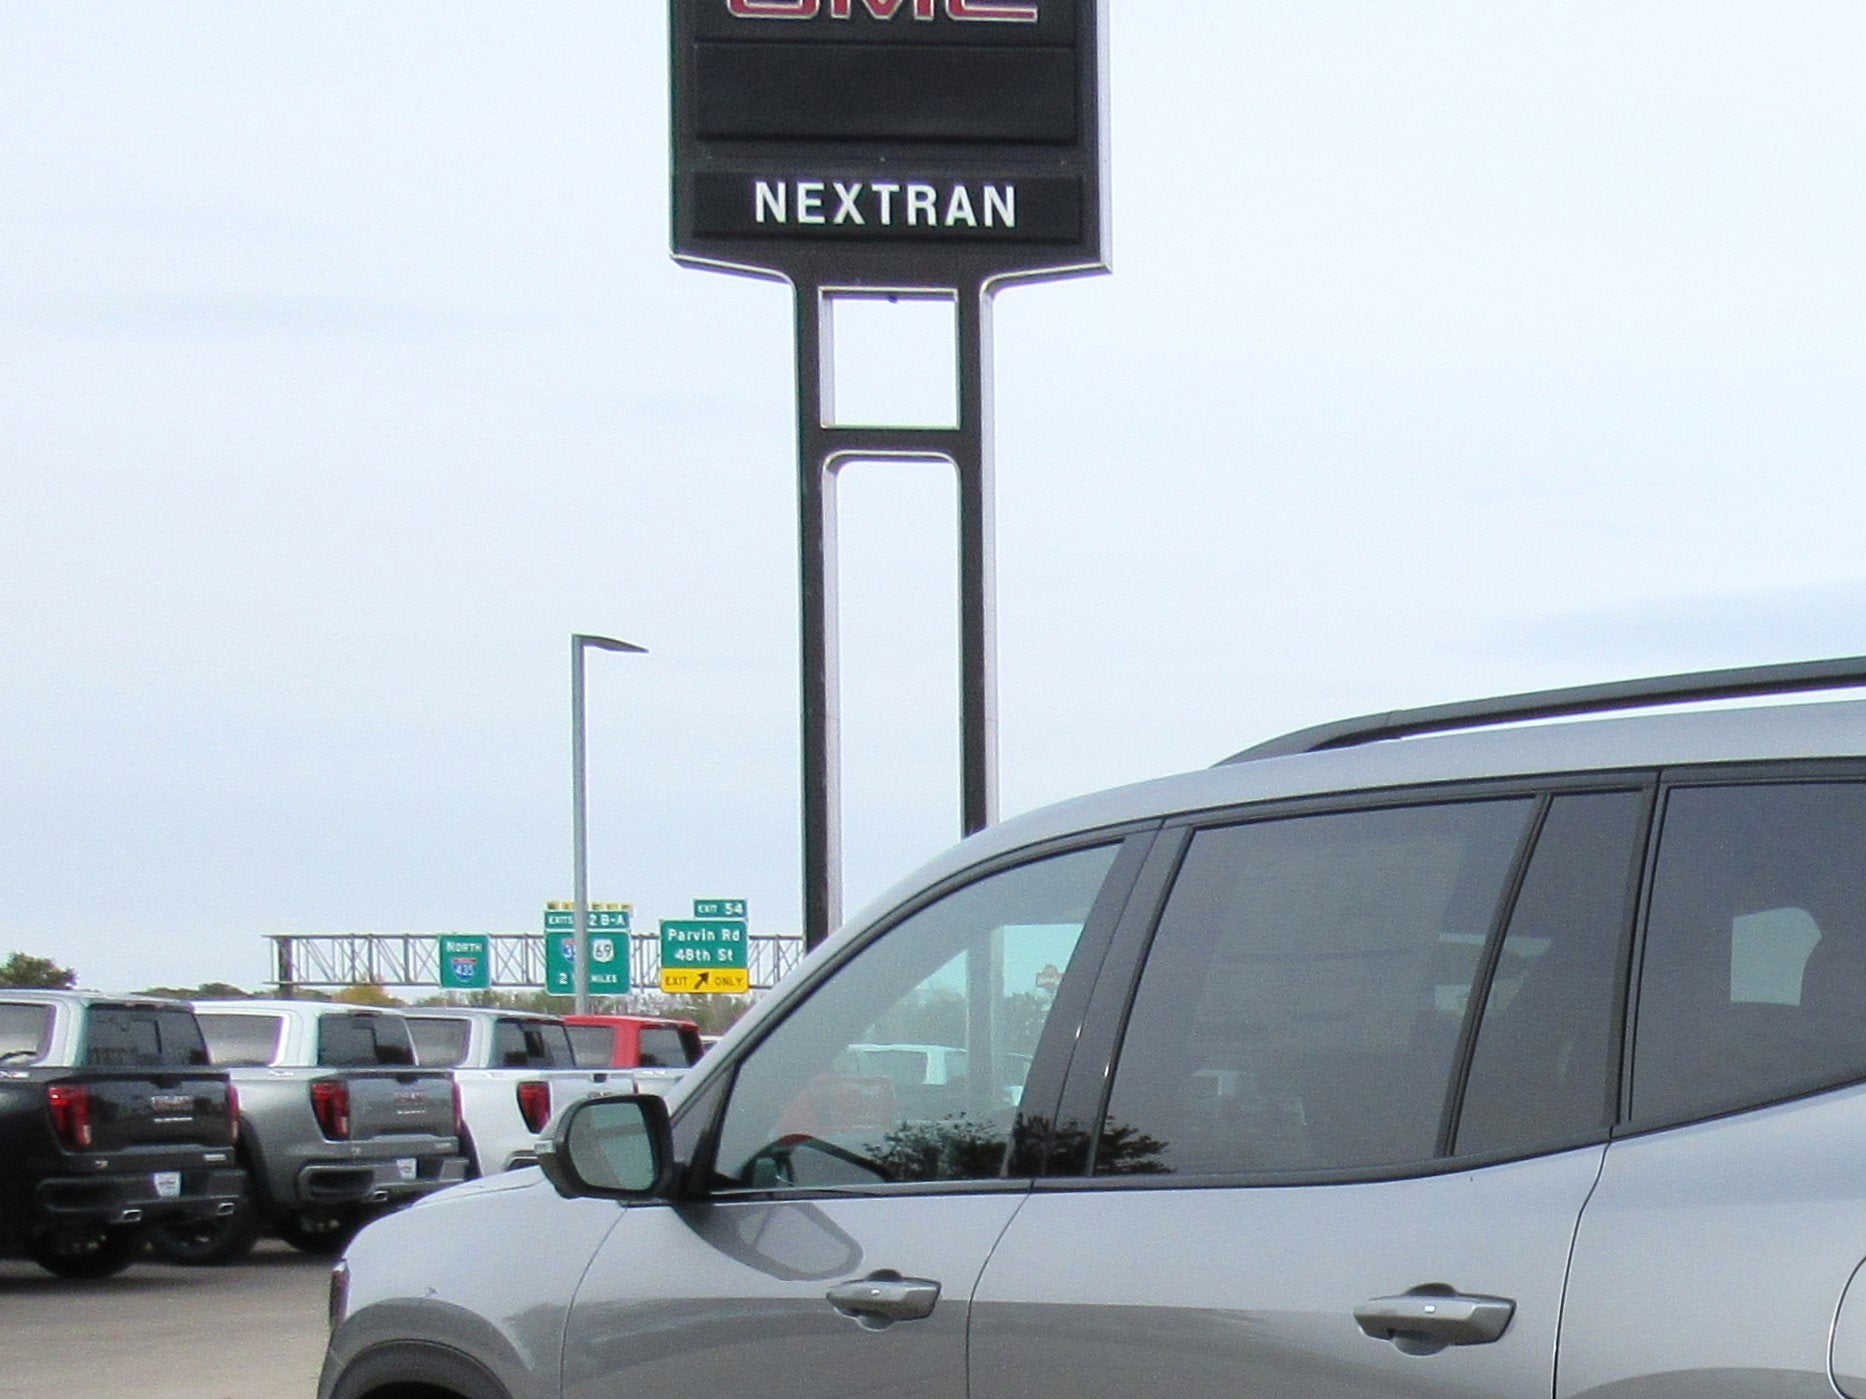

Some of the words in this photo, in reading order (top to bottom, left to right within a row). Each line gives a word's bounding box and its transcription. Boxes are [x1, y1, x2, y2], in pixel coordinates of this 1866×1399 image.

[754, 180, 1017, 228] NEXTRAN
[697, 904, 718, 913] EXIT
[724, 902, 744, 915] 54
[668, 928, 716, 942] Parvin
[722, 928, 741, 942] Rd
[446, 942, 482, 953] NORTH
[595, 944, 612, 959] 69
[674, 948, 711, 962] 48th
[717, 948, 733, 962] St
[559, 973, 568, 985] 2
[665, 976, 687, 986] EXIT
[714, 976, 743, 986] ONLY
